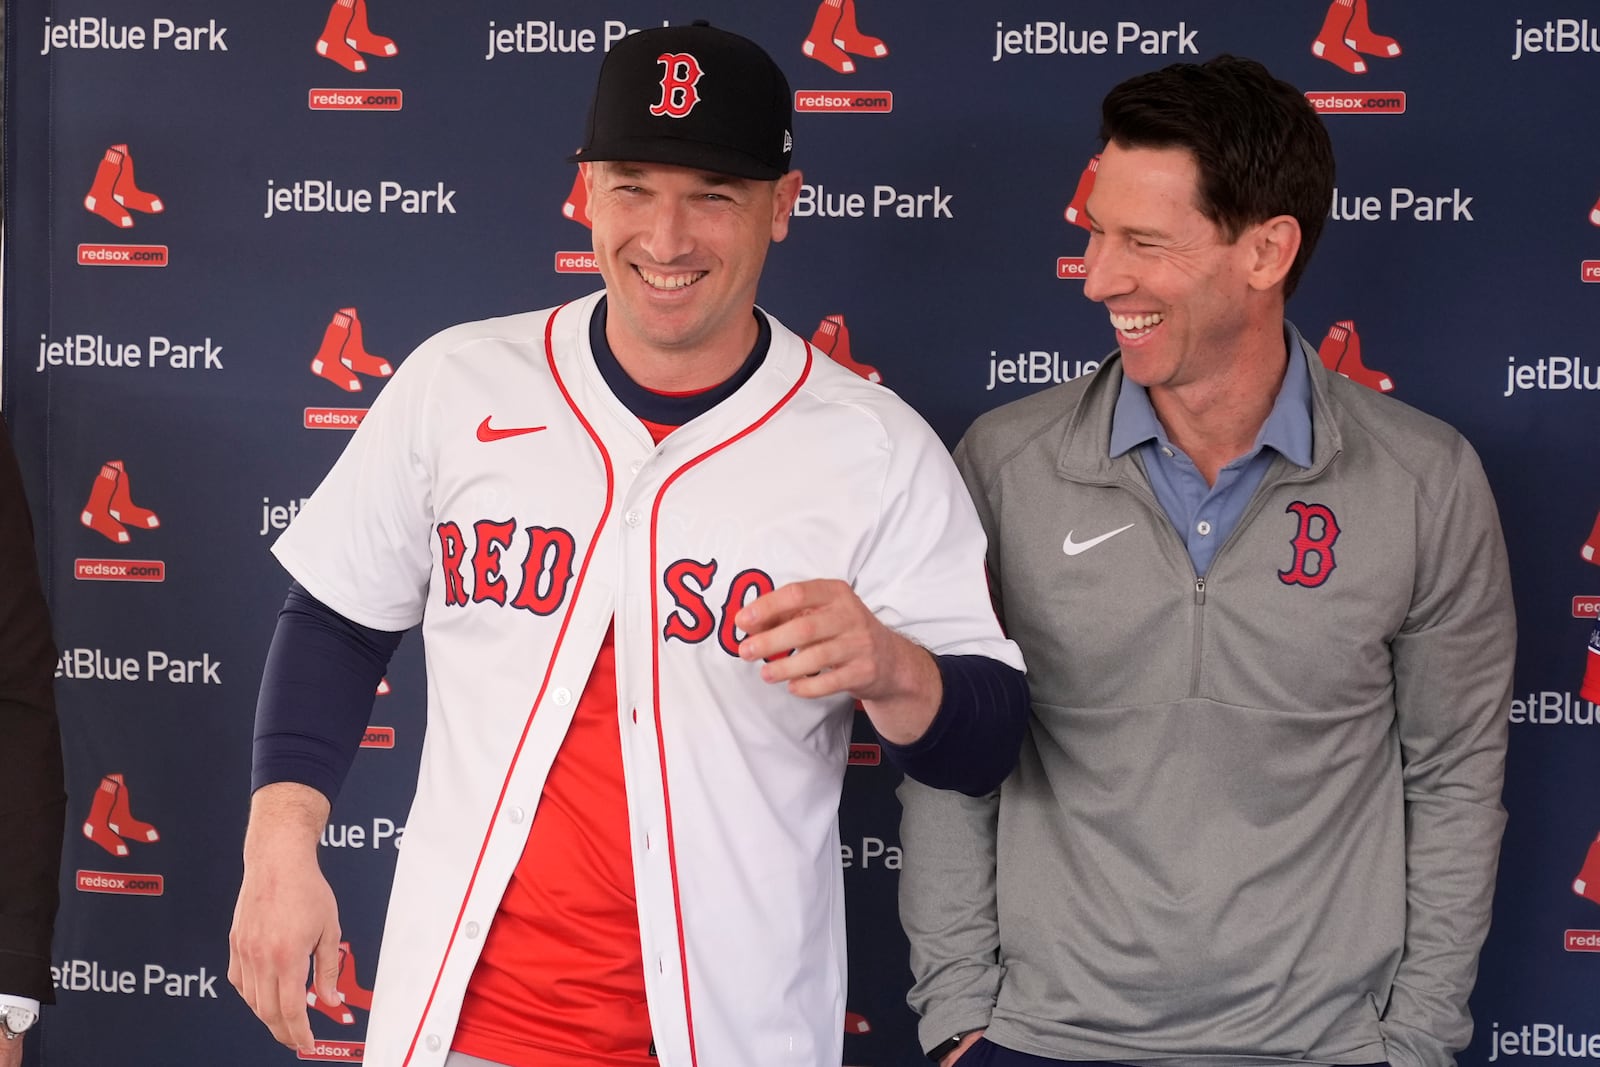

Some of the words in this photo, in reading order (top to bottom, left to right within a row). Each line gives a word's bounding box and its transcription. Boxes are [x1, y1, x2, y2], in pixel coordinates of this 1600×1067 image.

[40, 17, 145, 56] jetBlue
[154, 19, 228, 51] Park
[486, 21, 596, 60] jetBlue
[993, 21, 1108, 61] jetBlue
[1116, 22, 1199, 54] Park
[313, 93, 398, 106] redsox.com
[650, 52, 705, 118] B
[800, 95, 888, 107] redsox.com
[264, 180, 371, 218] jetBlue
[379, 182, 457, 214] Park
[794, 184, 865, 219] Blue
[873, 185, 954, 219] Park
[1390, 188, 1474, 221] Park
[82, 249, 164, 262] redsox.com
[37, 334, 142, 373] jetBlue
[149, 337, 224, 370] Park
[987, 350, 1100, 391] jetBlue
[1278, 501, 1341, 588] B
[80, 564, 161, 577] redsox.com
[437, 517, 576, 616] RED
[663, 556, 800, 664] SO
[148, 651, 222, 685] Park
[80, 876, 159, 890] redsox.com
[144, 963, 218, 999] Park
[1489, 1022, 1600, 1061] jetBlue
